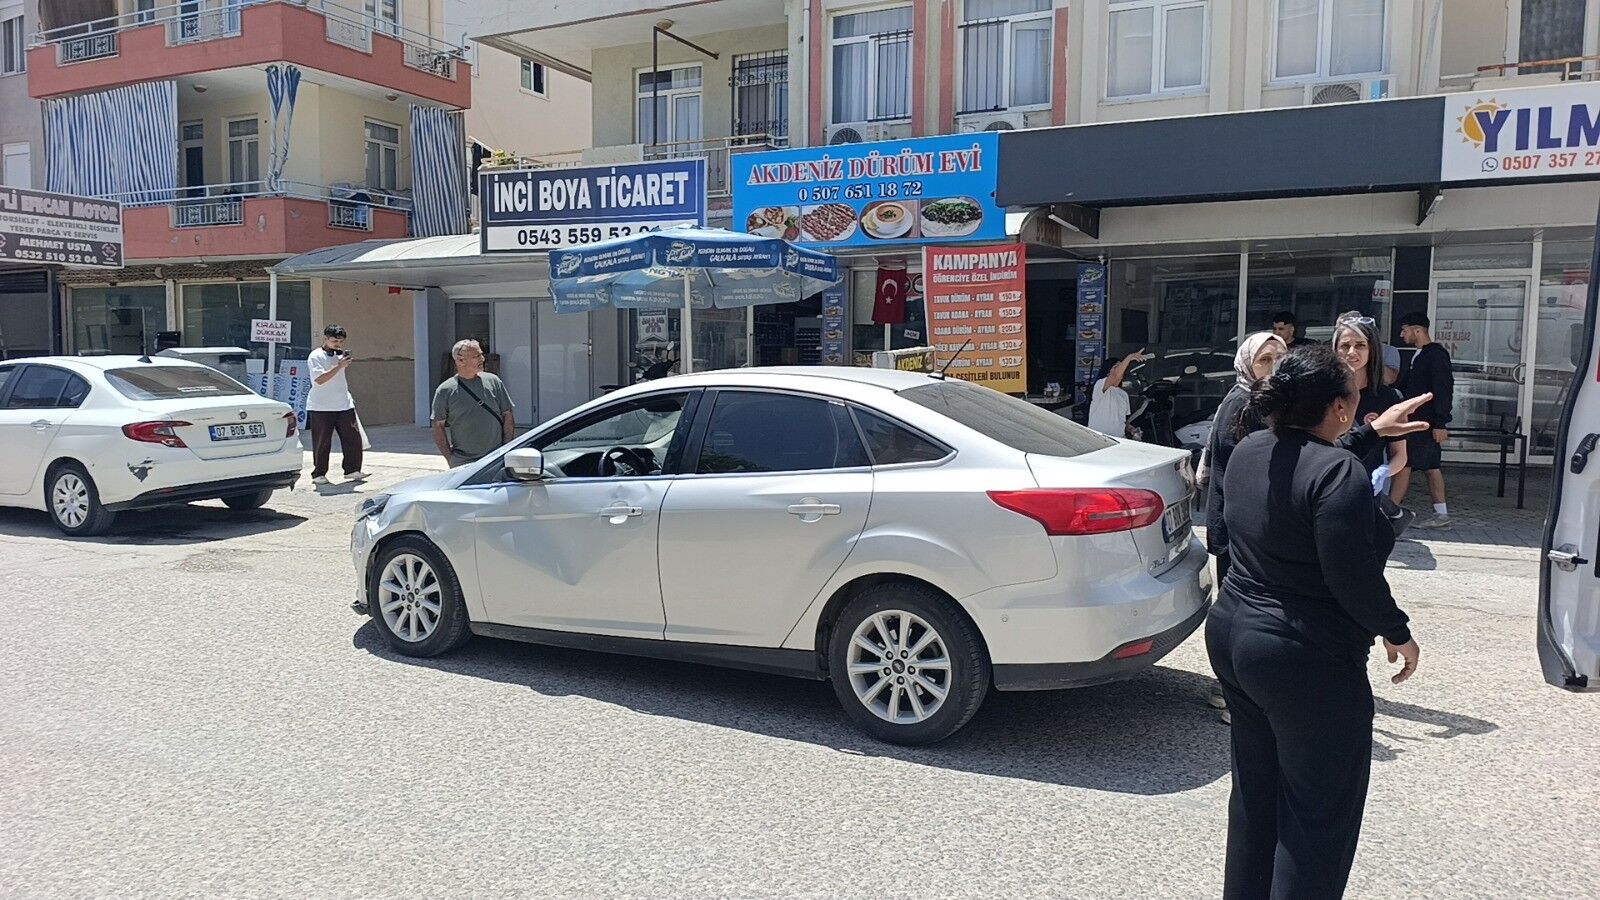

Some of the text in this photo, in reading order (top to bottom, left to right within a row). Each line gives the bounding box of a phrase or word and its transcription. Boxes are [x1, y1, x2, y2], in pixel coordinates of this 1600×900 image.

[747, 144, 982, 186] AKDENİZ DÜRÜM EVİ
[1502, 155, 1542, 170] 0507
[1548, 153, 1578, 168] 357
[494, 168, 689, 212] İNCİ BOYA TİCARET
[798, 181, 922, 201] 0 507 651 18 72
[72, 201, 118, 222] MOTOR
[20, 238, 92, 252] MEHMET USTA
[518, 228, 562, 246] 0543
[568, 228, 601, 244] 559
[14, 250, 43, 260] 0532
[46, 252, 66, 262] 510
[68, 254, 82, 263] 52
[84, 255, 98, 264] 04
[933, 250, 1017, 271] KAMPANYA
[971, 272, 988, 282] ÖZEL
[216, 427, 226, 437] 07
[249, 425, 263, 434] 667
